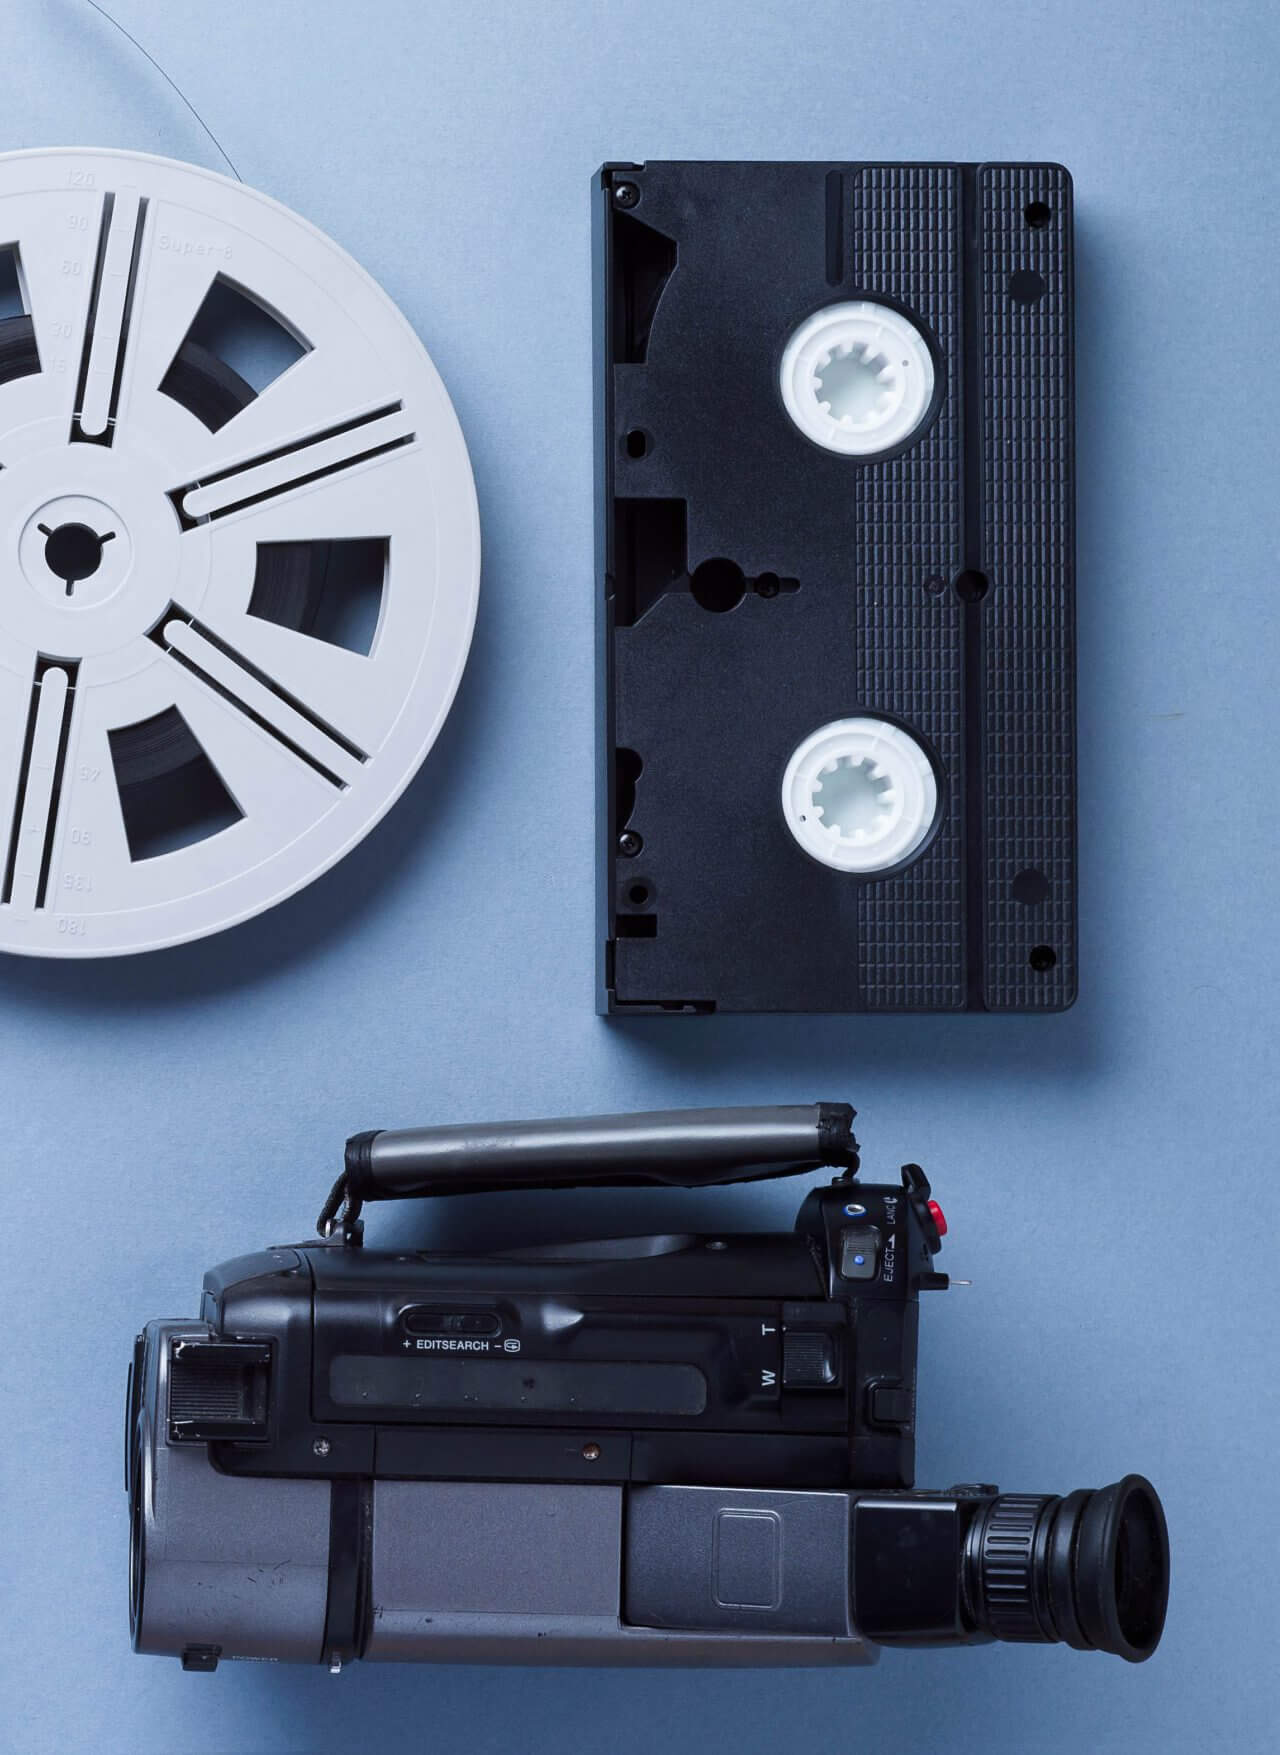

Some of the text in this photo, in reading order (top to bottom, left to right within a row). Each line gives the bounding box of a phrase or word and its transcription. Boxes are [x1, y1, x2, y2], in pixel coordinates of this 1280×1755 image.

[883, 1248, 895, 1282] EJECT
[761, 1323, 776, 1336] T
[416, 1339, 489, 1351] EDITSEARCH
[761, 1369, 776, 1386] W
